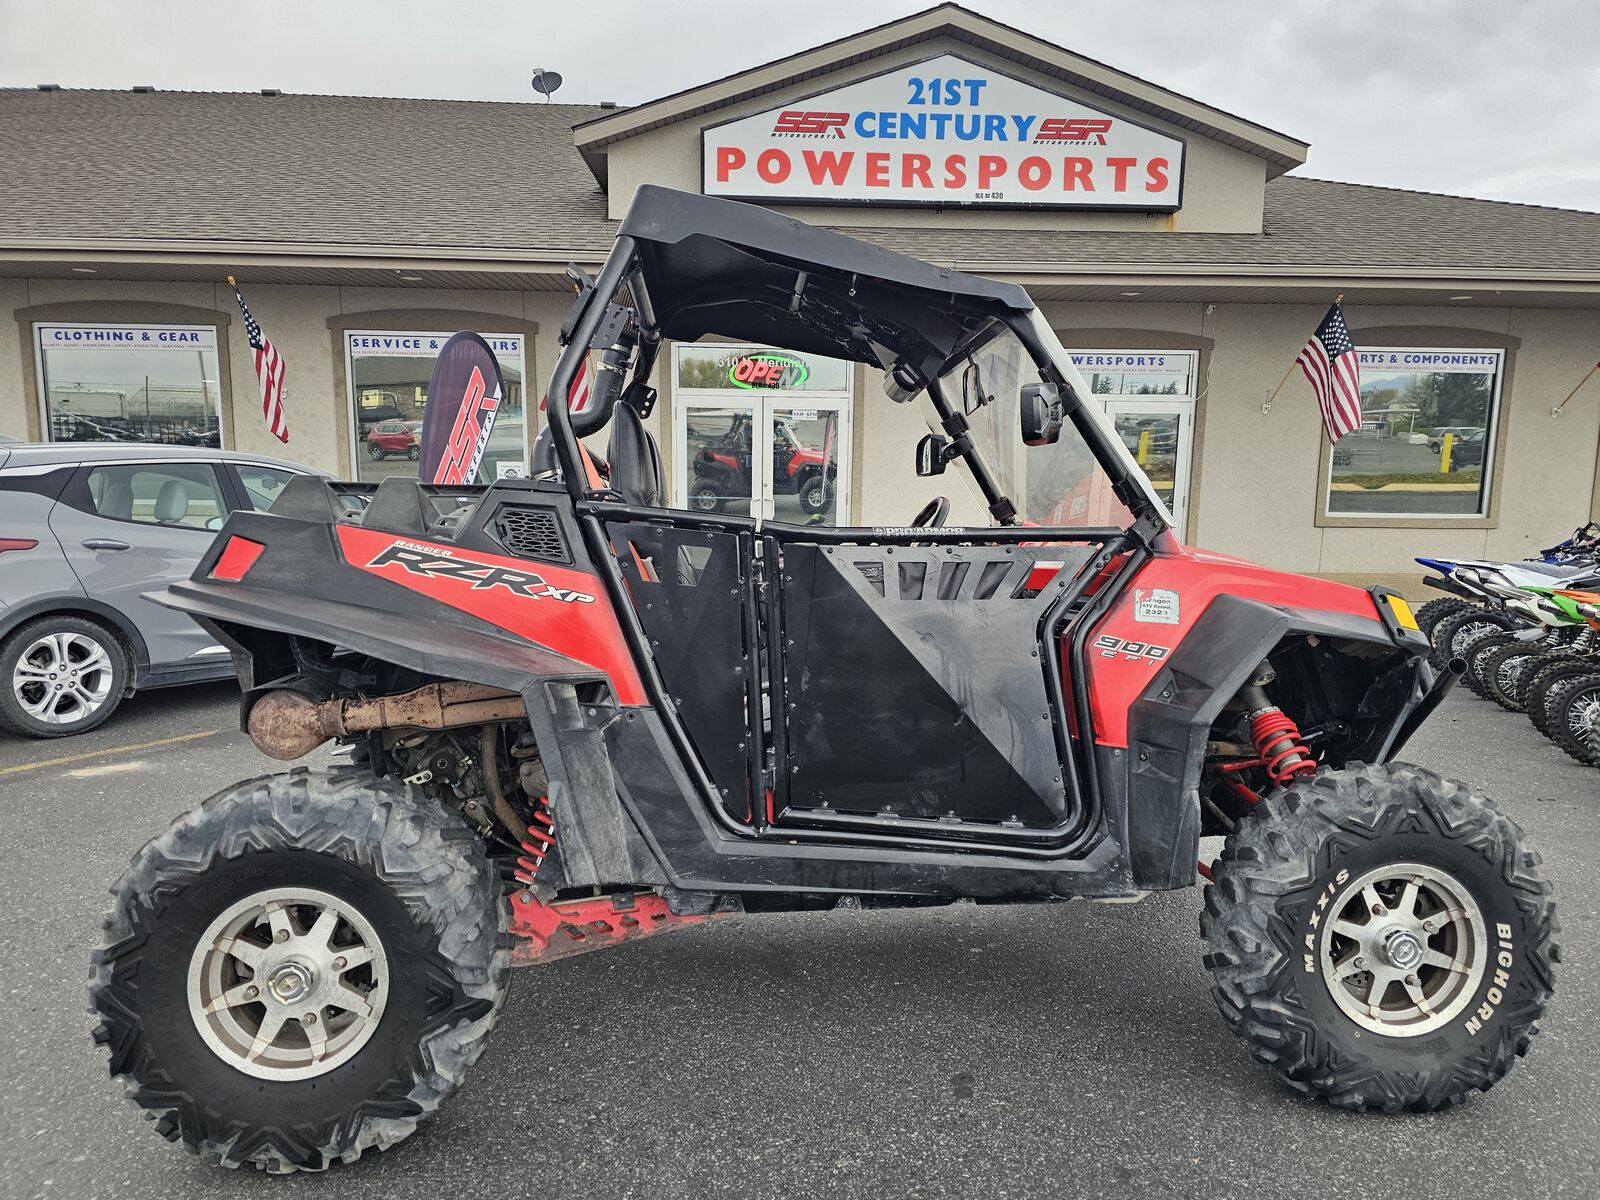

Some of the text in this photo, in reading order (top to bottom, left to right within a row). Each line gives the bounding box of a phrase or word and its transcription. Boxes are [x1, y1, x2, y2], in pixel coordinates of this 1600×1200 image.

[907, 77, 987, 106] 21ST
[773, 111, 850, 139] SSR
[854, 111, 1037, 142] CENTURY
[1035, 119, 1112, 146] SSR
[717, 146, 1169, 193] POWERSPORTS
[54, 331, 200, 342] CLOTHING & GEAR
[353, 338, 439, 349] SERVICE &
[718, 356, 738, 368] 310
[1071, 356, 1165, 366] WERSPORTS
[1360, 354, 1494, 364] RTS & COMPONENTS
[734, 360, 800, 389] OPEN
[465, 413, 492, 484] RSPORTS
[394, 540, 453, 556] RANGER
[365, 544, 596, 604] RZR XP
[1093, 634, 1171, 661] 900
[1100, 649, 1154, 666] EFI
[1303, 868, 1349, 973] MAXXIS
[1464, 923, 1513, 1036] BIGHORN
